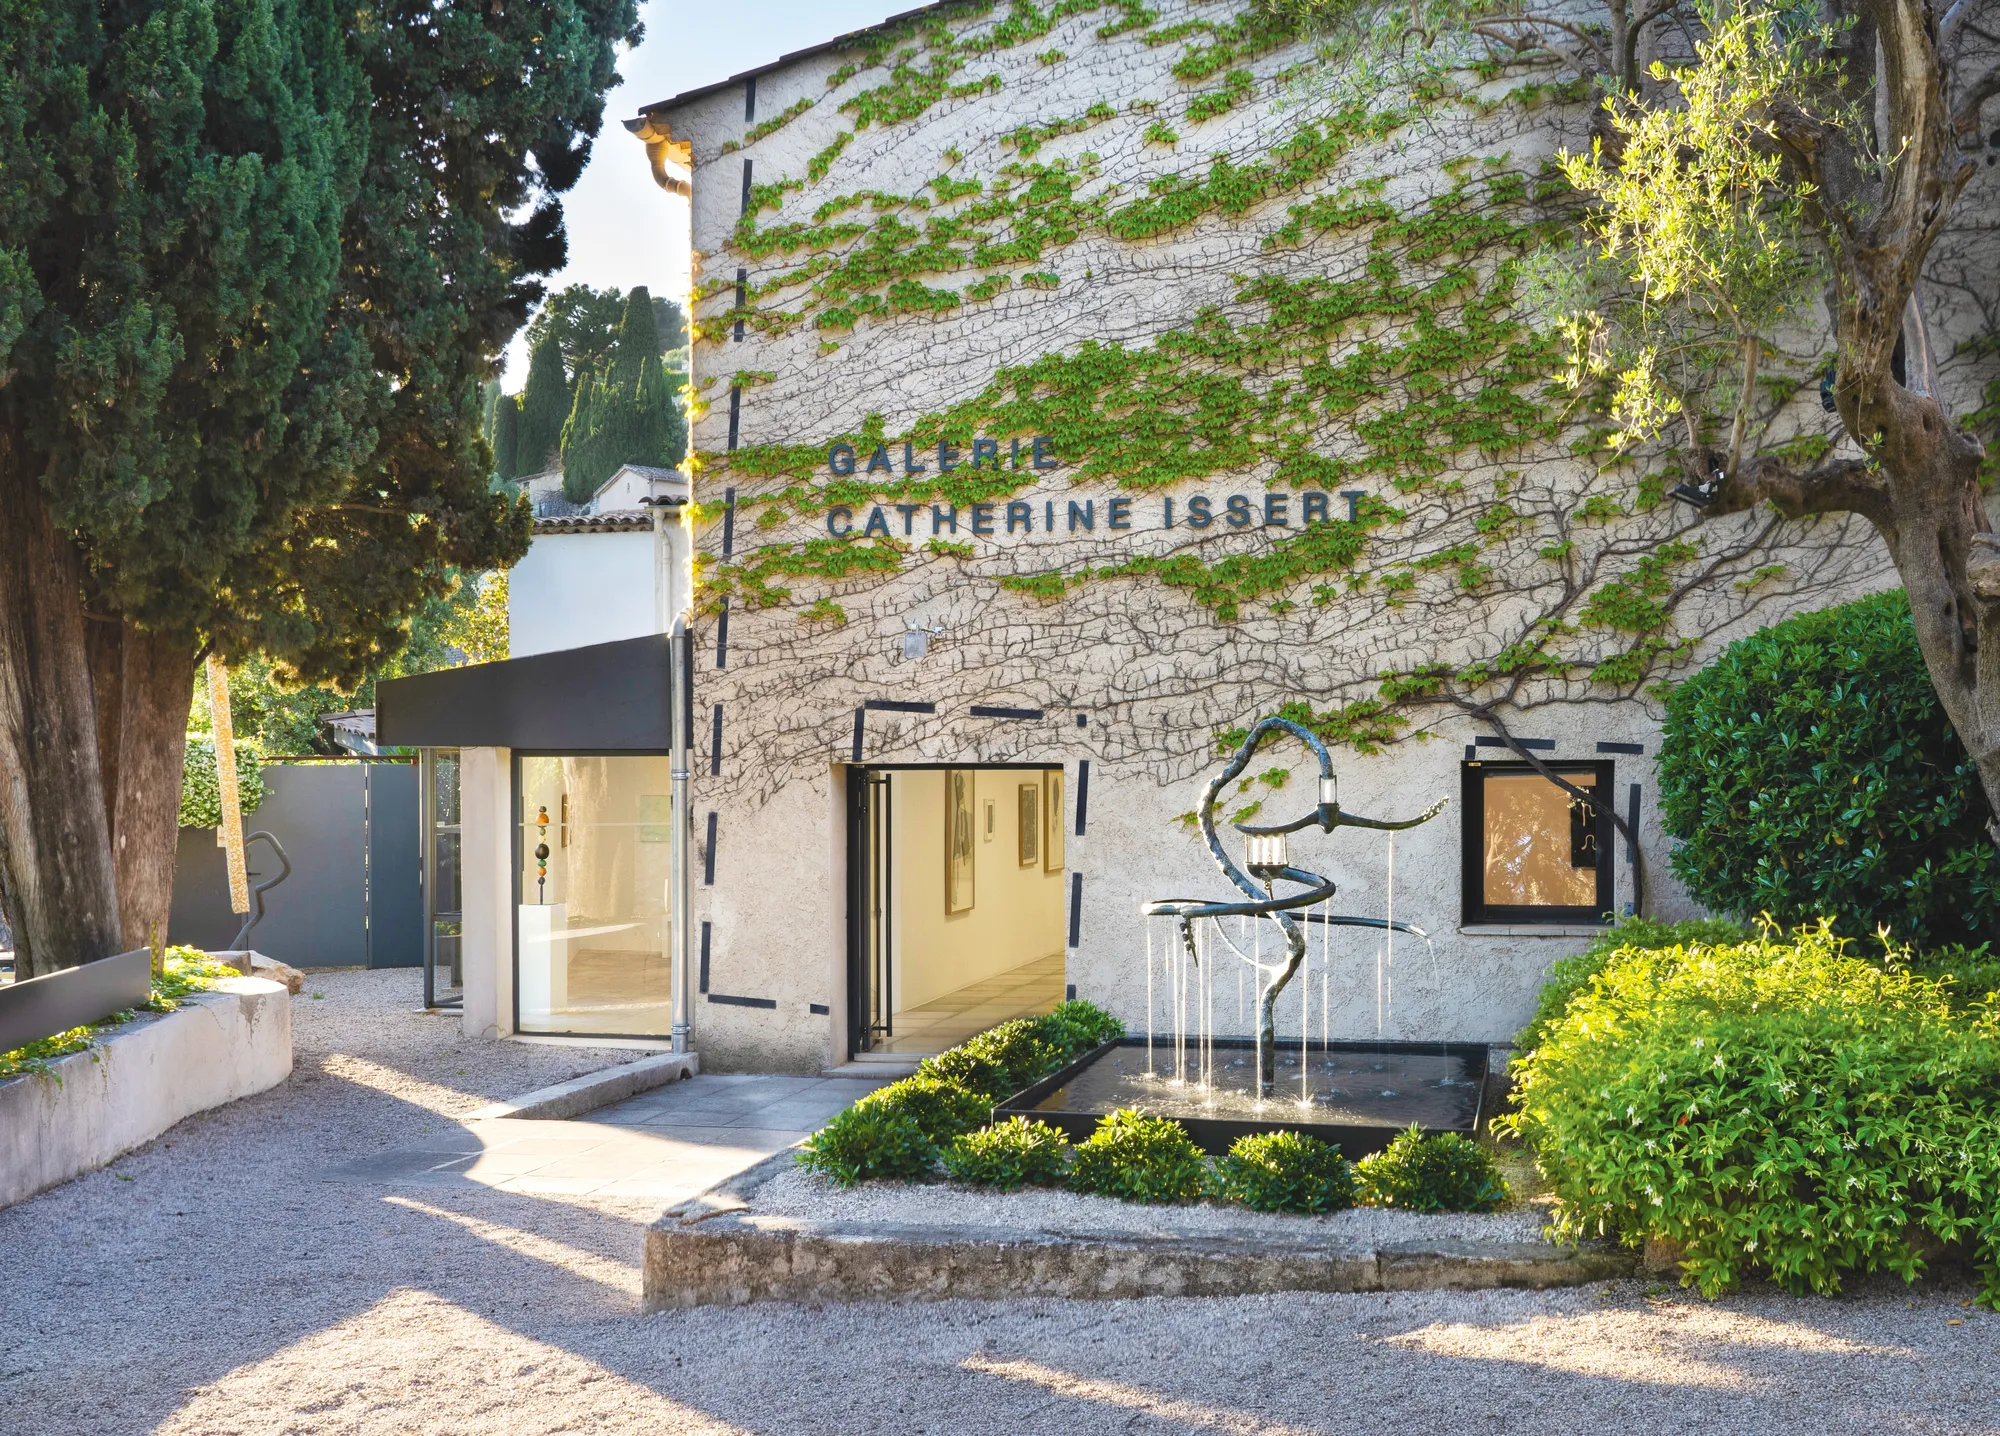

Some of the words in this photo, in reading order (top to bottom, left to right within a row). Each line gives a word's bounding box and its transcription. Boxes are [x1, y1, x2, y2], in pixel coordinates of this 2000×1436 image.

[828, 436, 1056, 475] GALERIE
[827, 499, 1131, 537] CATHERINE
[1165, 491, 1365, 528] ISSERT
